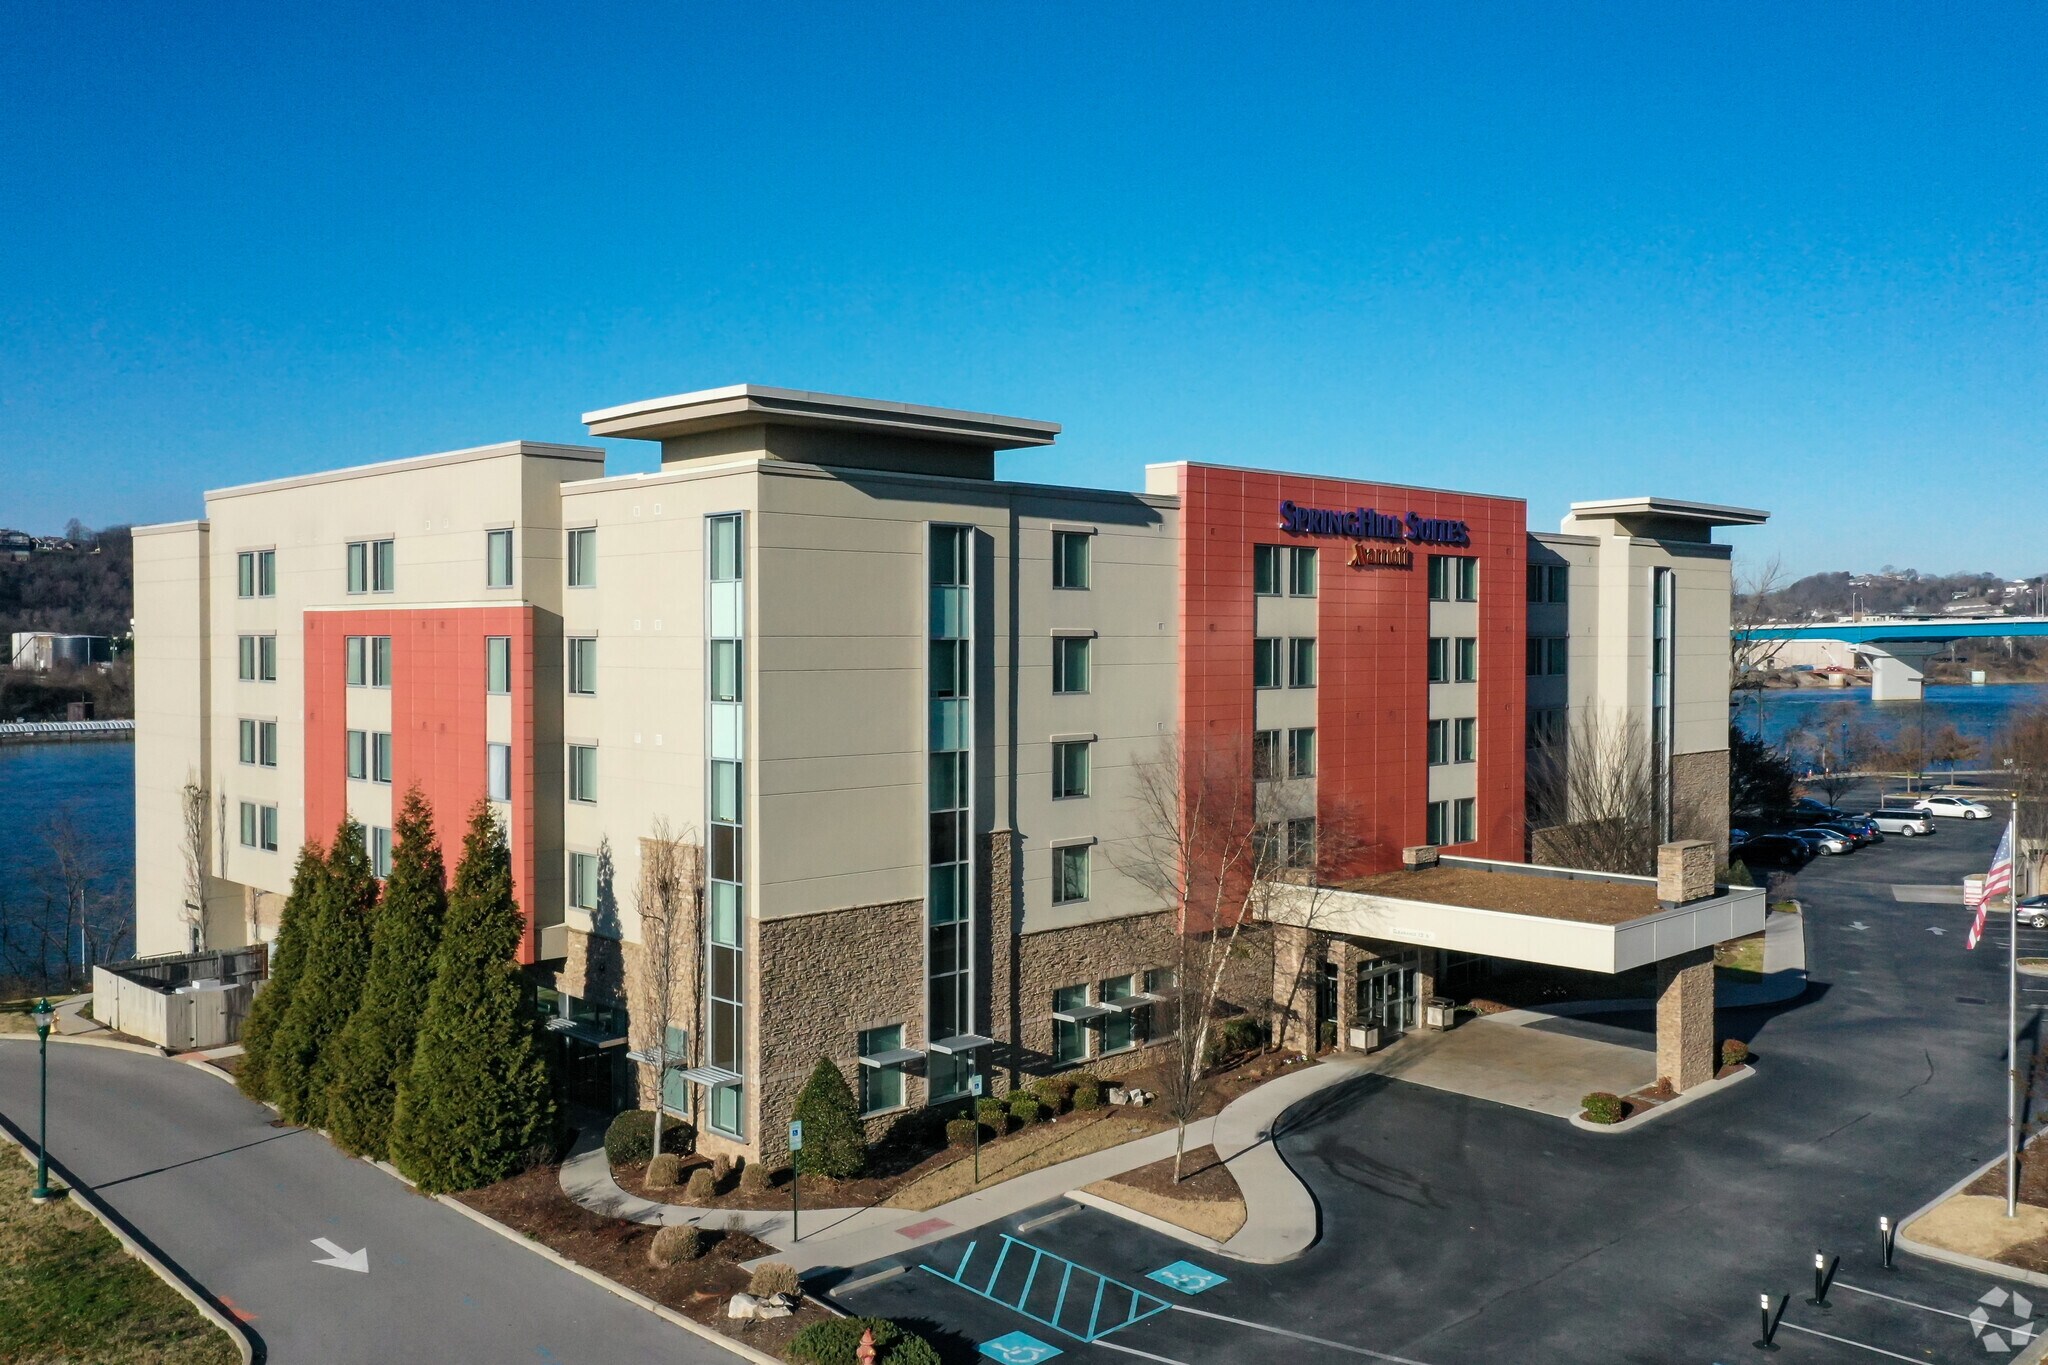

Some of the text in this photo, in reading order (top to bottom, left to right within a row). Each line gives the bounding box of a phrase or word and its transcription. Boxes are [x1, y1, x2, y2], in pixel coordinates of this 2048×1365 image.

[1280, 500, 1467, 542] SPRINGHILL SUITES
[1348, 543, 1409, 566] Marriott
